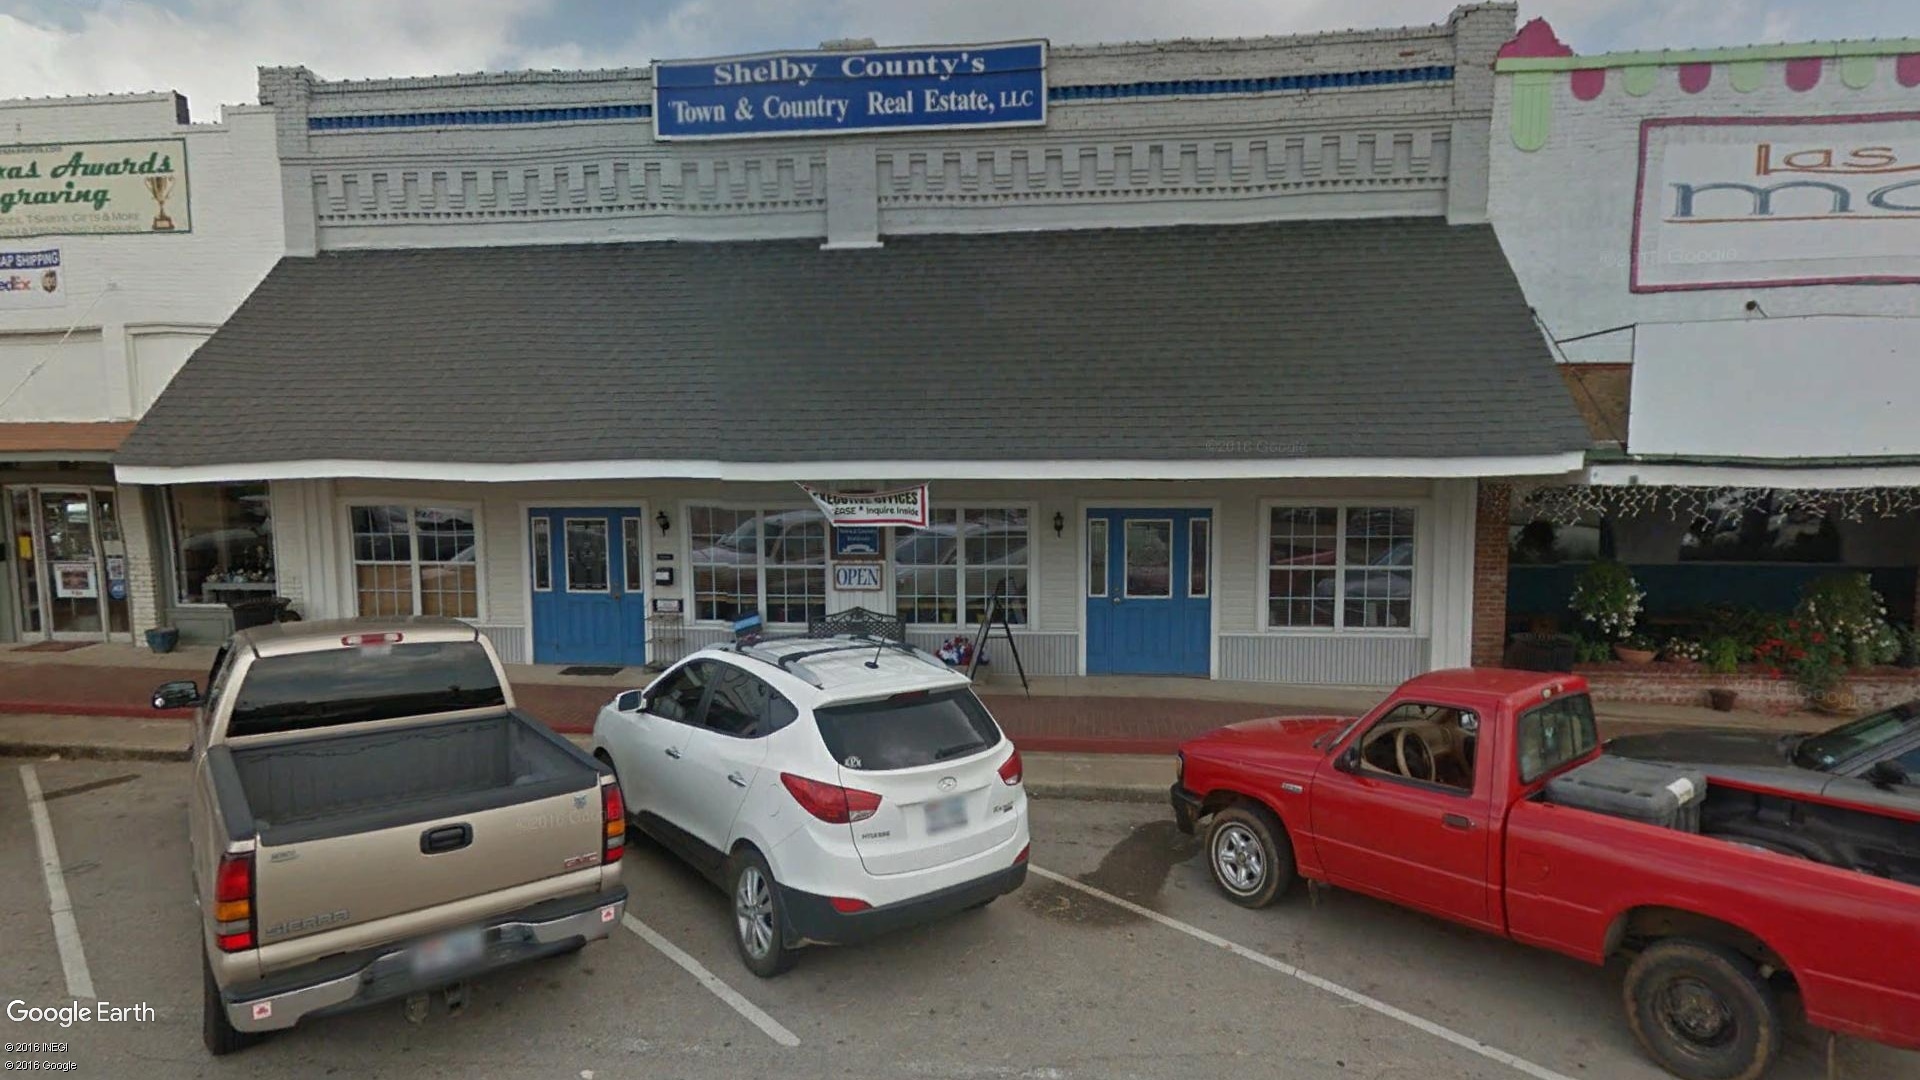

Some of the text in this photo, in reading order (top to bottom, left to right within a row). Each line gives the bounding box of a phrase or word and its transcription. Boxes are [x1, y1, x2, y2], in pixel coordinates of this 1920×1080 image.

[713, 52, 986, 86] Shelby County's
[668, 89, 1034, 123] Town & Country Real Estate, LLC
[50, 152, 175, 178] Awards
[0, 181, 111, 213] graving
[15, 251, 58, 267] SHIPPING
[866, 506, 895, 516] Inquire
[897, 506, 919, 516] Inside
[836, 567, 878, 586] OPEN
